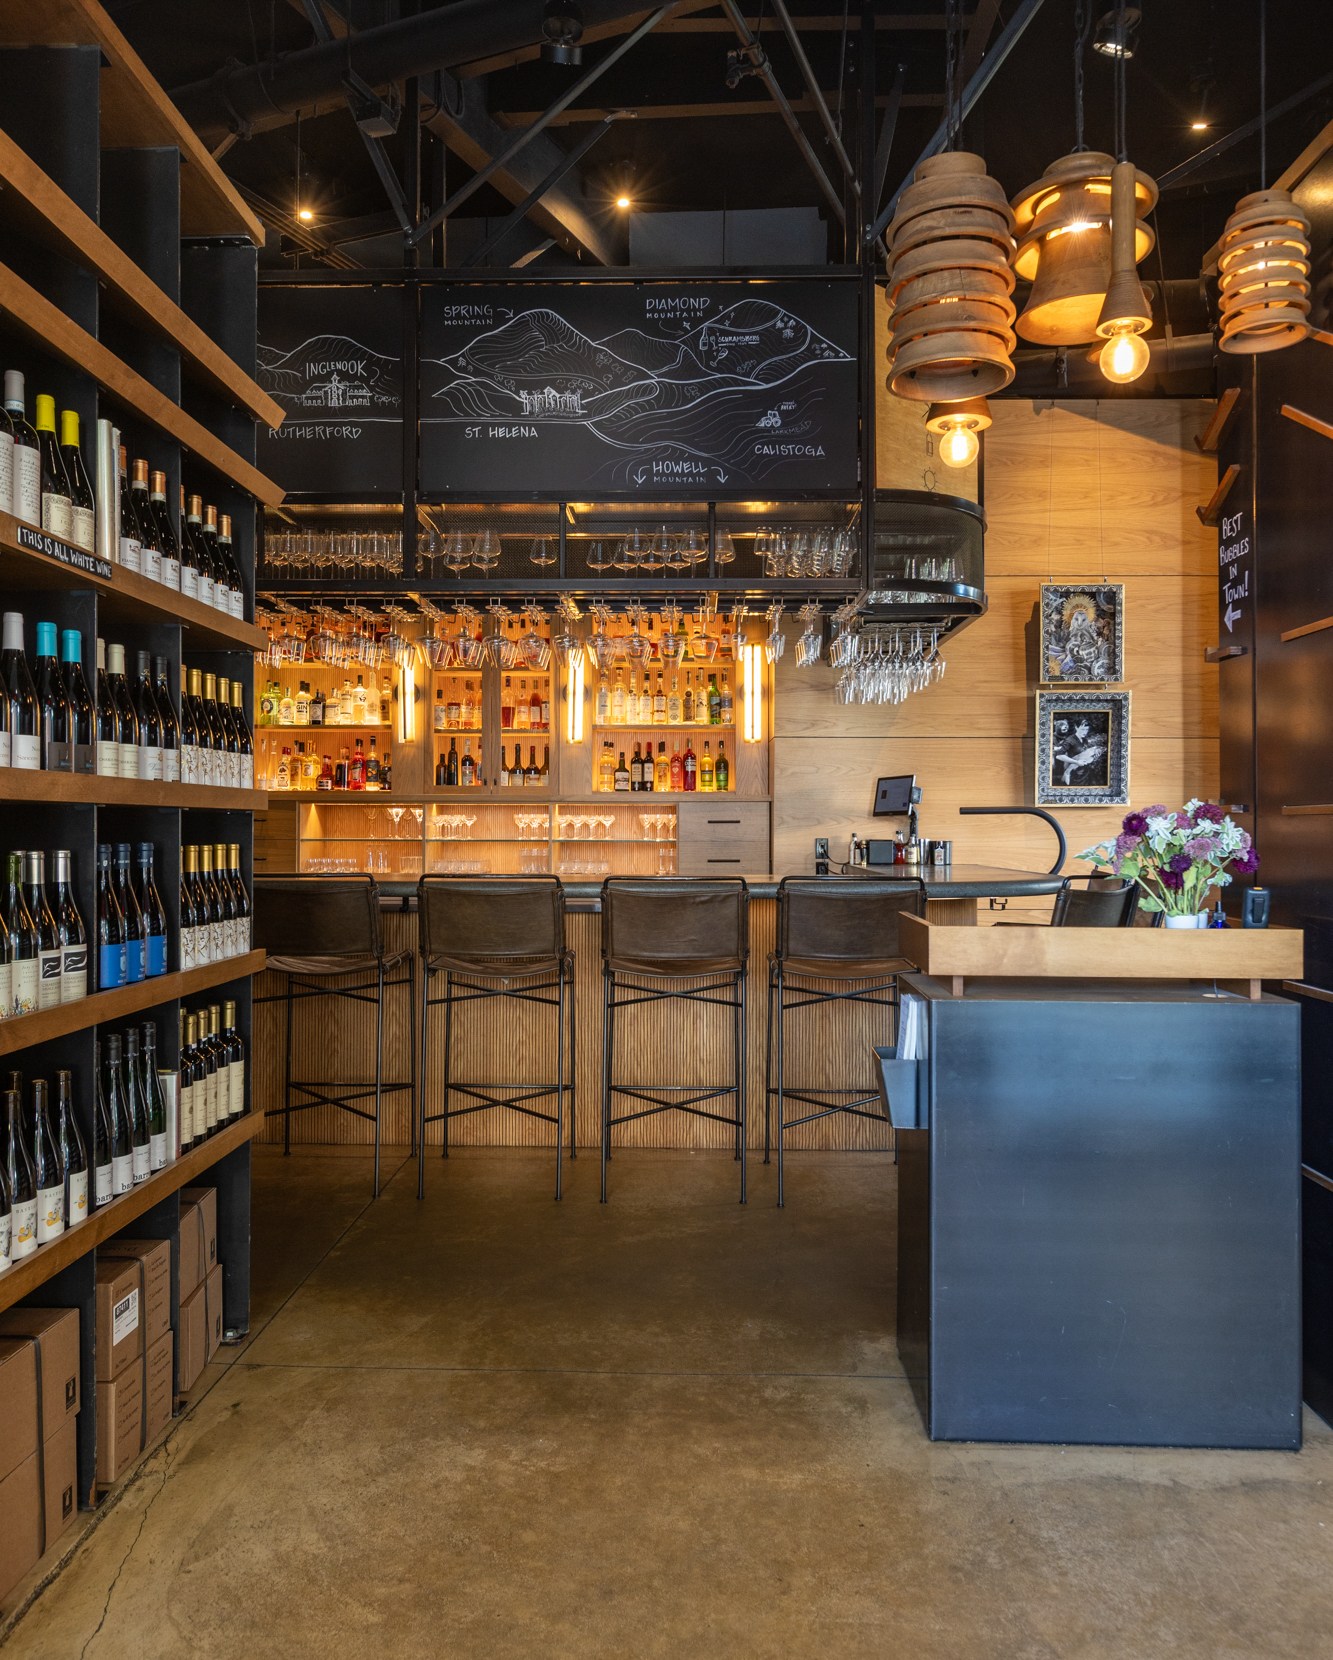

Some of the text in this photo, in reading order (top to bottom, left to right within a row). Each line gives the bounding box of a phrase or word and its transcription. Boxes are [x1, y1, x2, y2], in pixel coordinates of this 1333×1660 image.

[646, 297, 710, 309] DIAMOND
[444, 305, 493, 318] SPRING
[647, 311, 703, 319] MOUNTAIN
[306, 360, 368, 380] INGLENOOK
[268, 425, 362, 440] RUTHERFORD
[464, 426, 539, 438] ST. HELENA
[754, 444, 826, 456] CALISTOGA
[652, 461, 708, 474] HOWELL
[653, 476, 707, 484] MOUNTAIN
[1222, 512, 1243, 539] BEST
[22, 528, 43, 550] THIS
[44, 537, 53, 554] IS
[54, 541, 69, 562] ALL
[69, 549, 96, 572] WHITE
[1219, 537, 1250, 566] BUBBLES
[1229, 564, 1237, 578] IN
[1222, 570, 1249, 604] TOWN!
